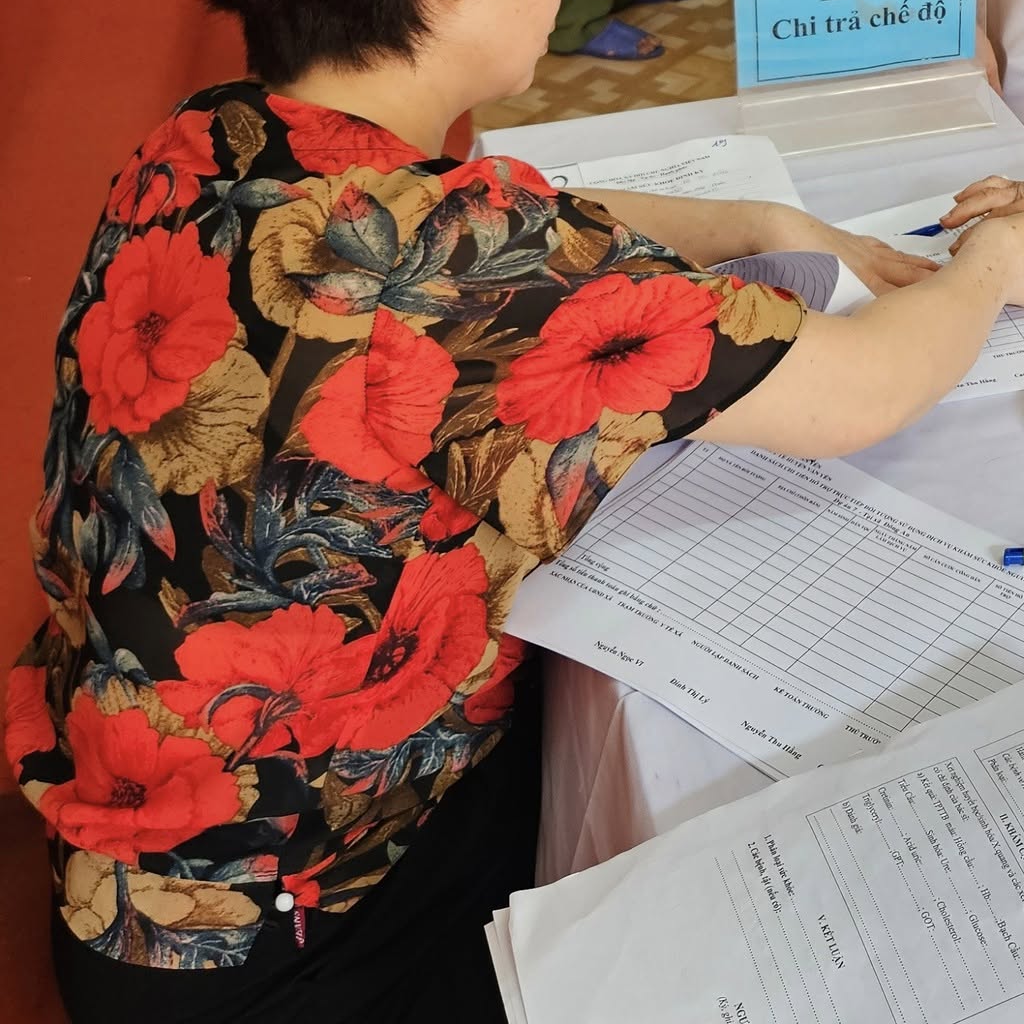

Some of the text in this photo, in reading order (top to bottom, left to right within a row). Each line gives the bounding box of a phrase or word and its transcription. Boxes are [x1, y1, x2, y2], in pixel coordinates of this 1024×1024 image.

[772, 0, 947, 40] Chi trả chế độ
[594, 640, 634, 662] Nguyễn Ngọc
[669, 678, 710, 704] Đinh Thị Lý
[740, 720, 802, 760] Nguyễn Thu Hằng
[999, 813, 1008, 823] II.
[1004, 822, 1024, 848] KHÁM
[903, 837, 917, 851] Acid
[953, 836, 967, 856] Hồng
[1007, 869, 1016, 878] và
[1011, 878, 1021, 890] các
[818, 914, 846, 969] V. KẾT LUẬN
